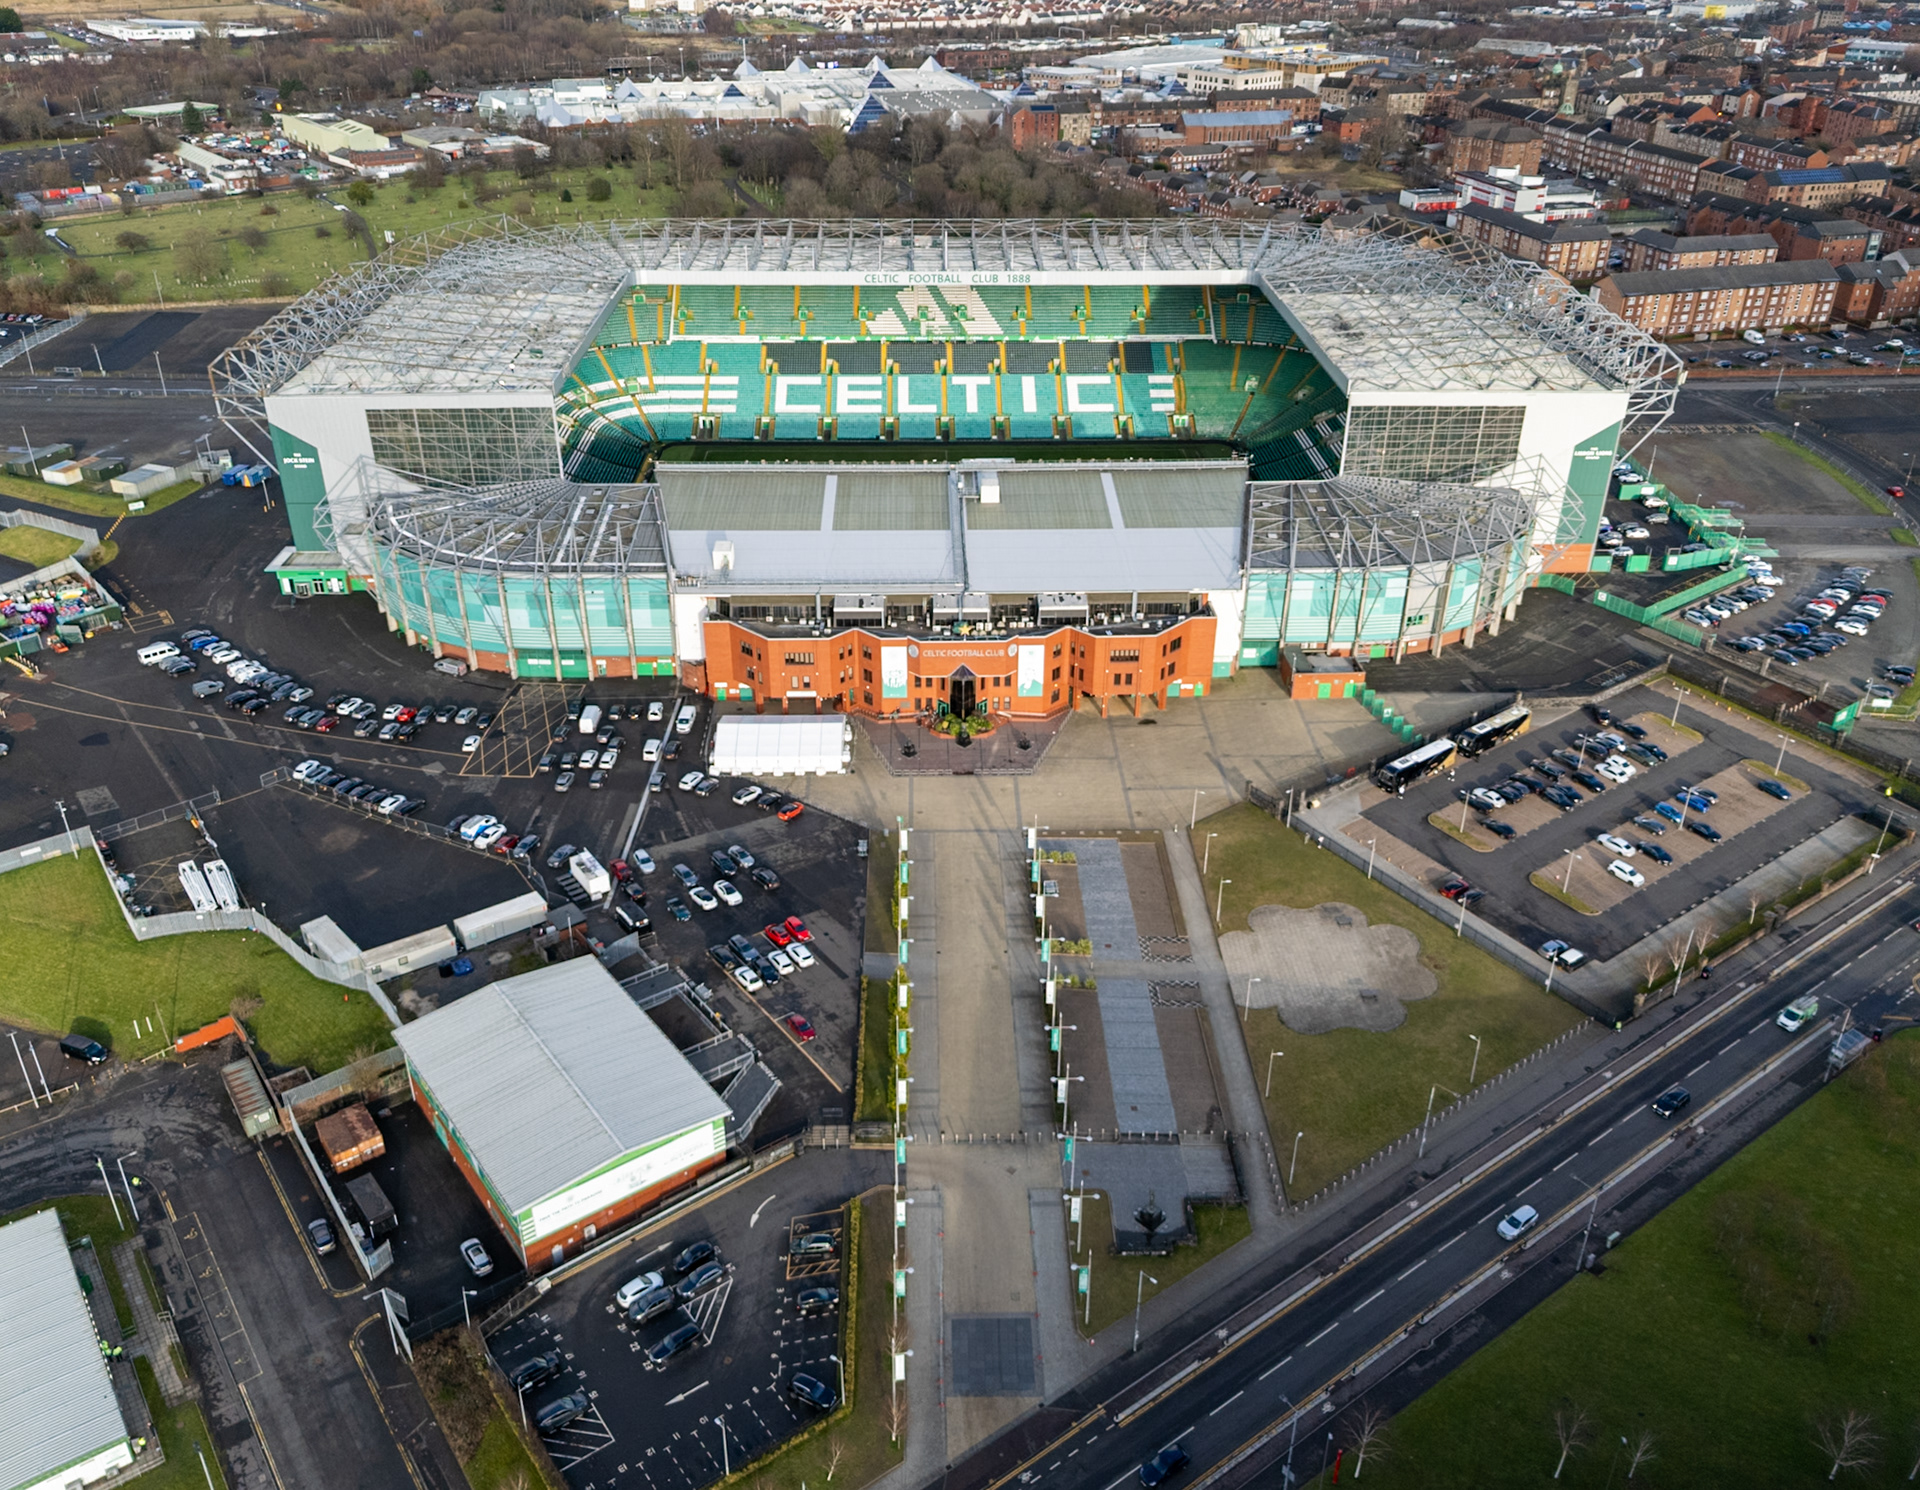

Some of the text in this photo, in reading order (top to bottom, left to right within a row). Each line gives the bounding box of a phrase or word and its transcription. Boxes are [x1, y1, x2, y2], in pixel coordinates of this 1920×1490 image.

[864, 274, 1031, 283] CELTIC FOOTBALL CLUB 1888
[774, 376, 1114, 413] CELTIC
[985, 649, 1004, 657] CLUB
[630, 1342, 640, 1352] 22
[699, 1416, 709, 1424] 10
[646, 1447, 655, 1456] 12
